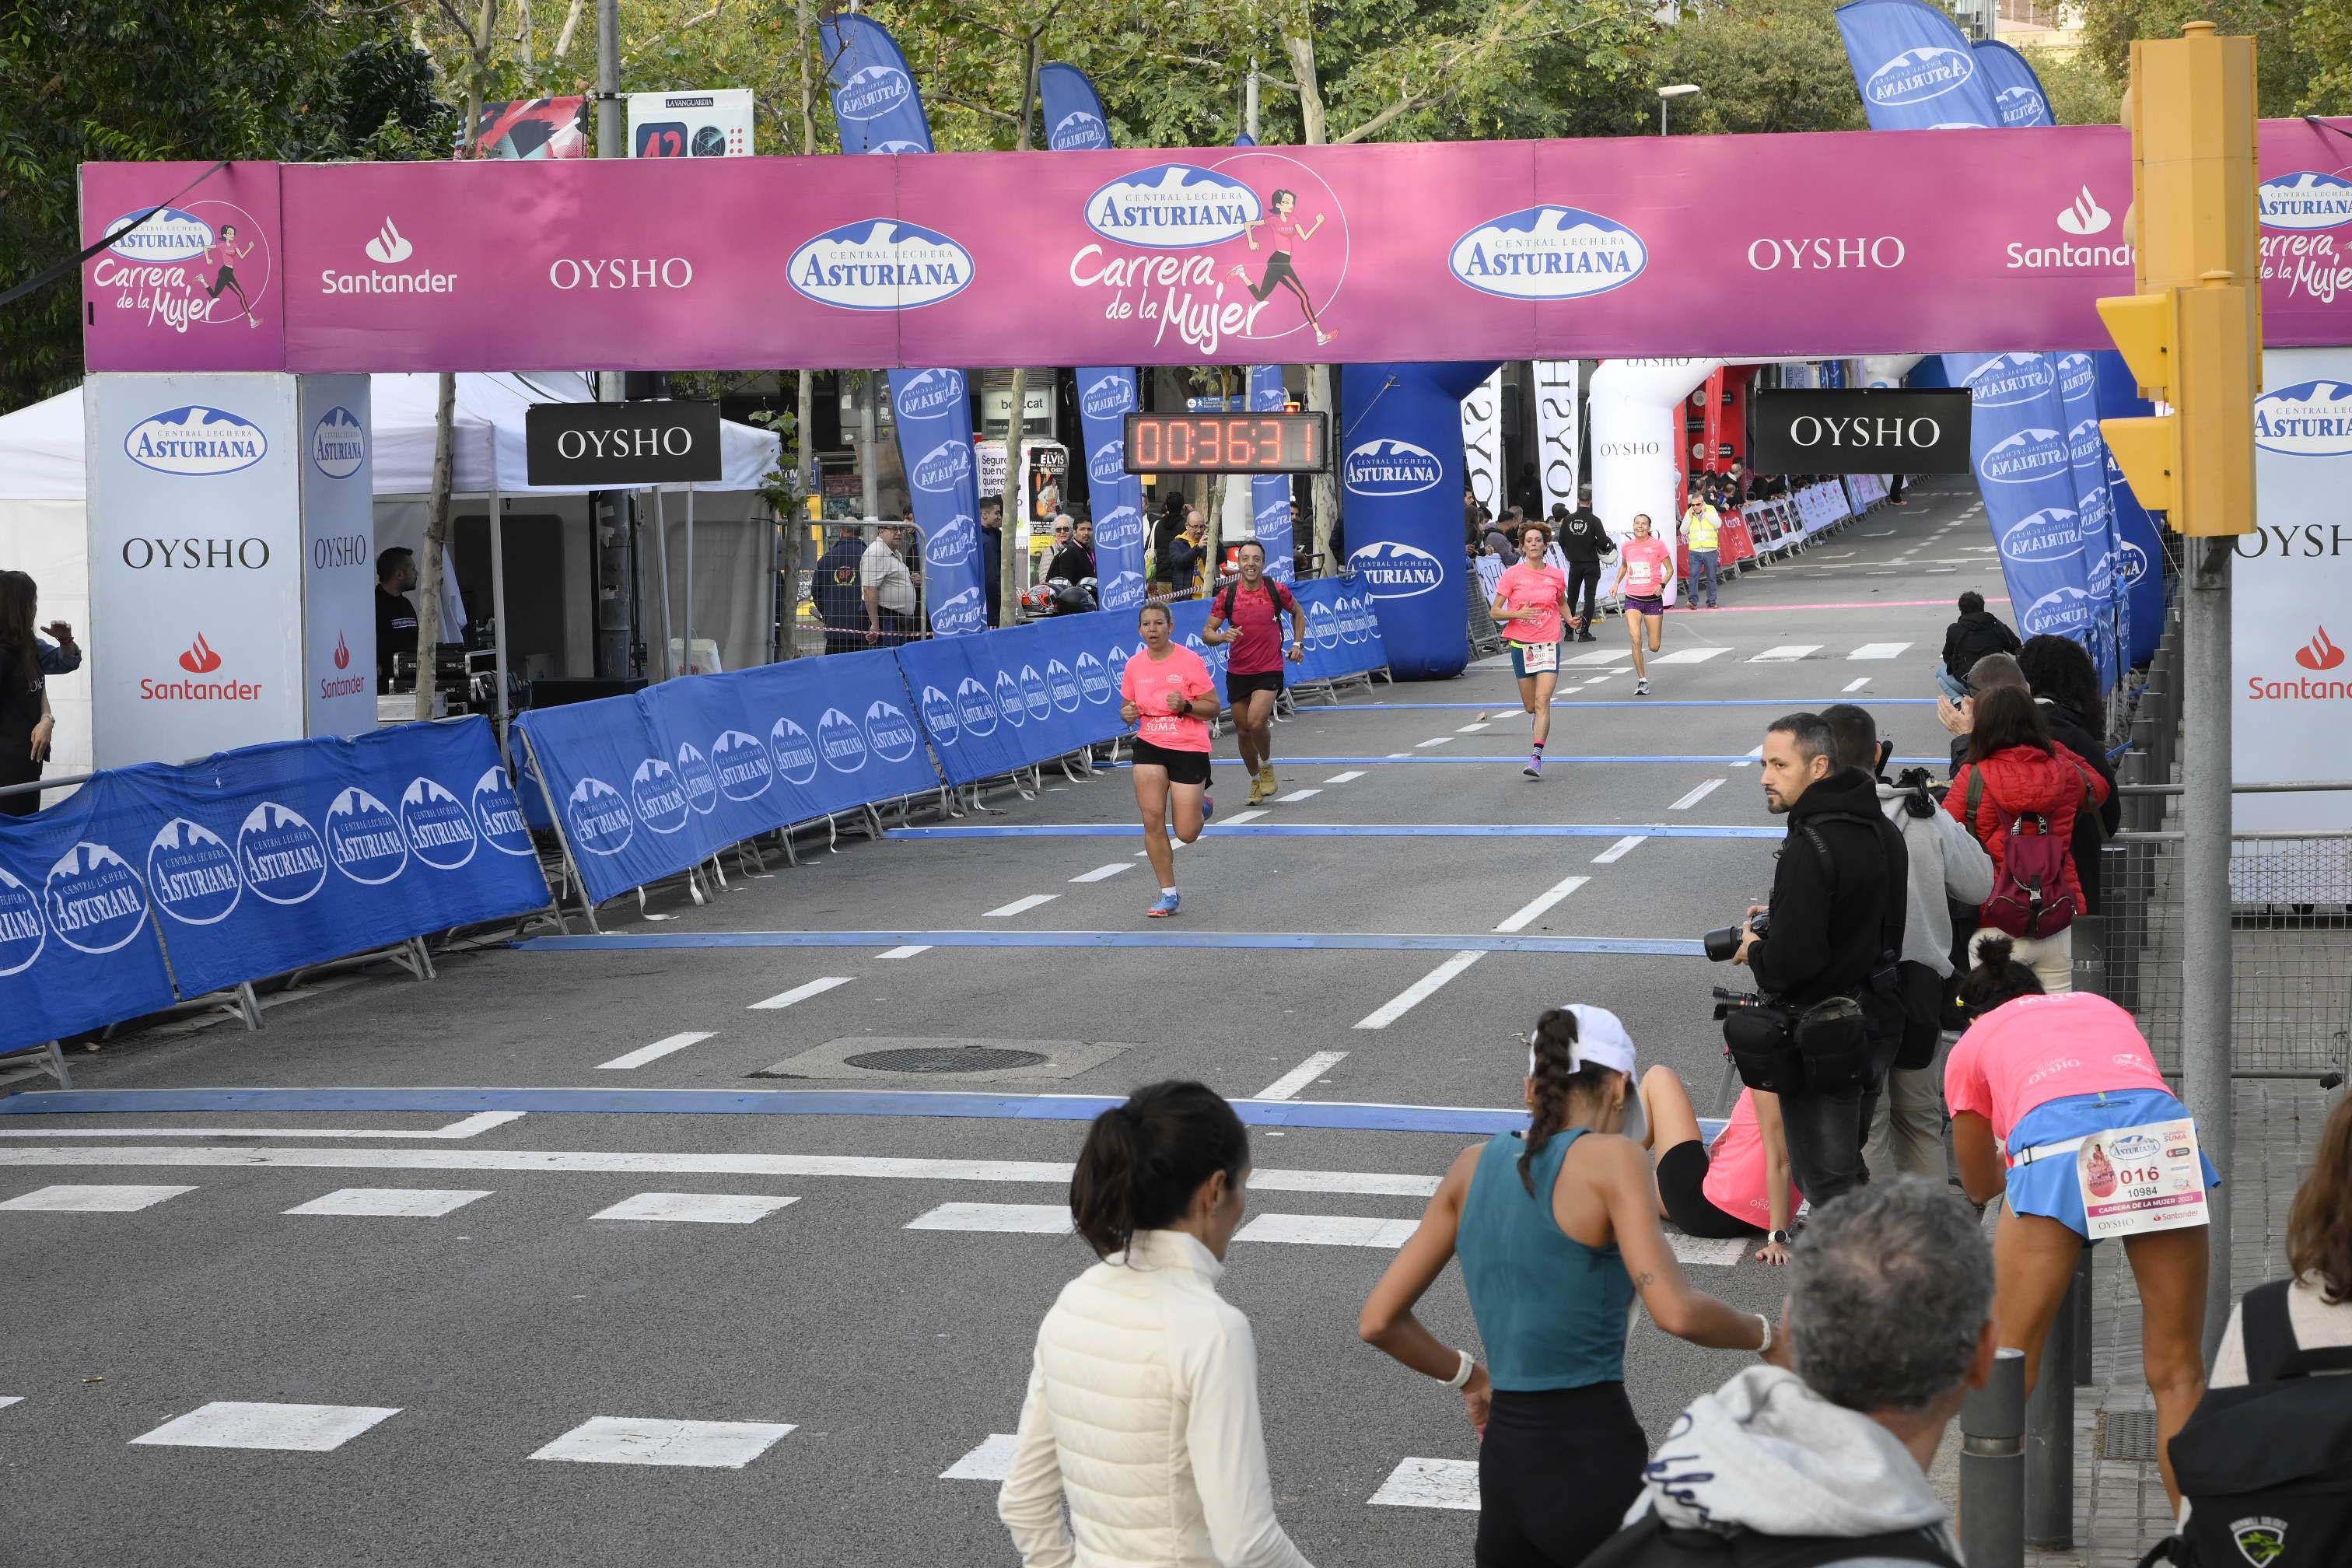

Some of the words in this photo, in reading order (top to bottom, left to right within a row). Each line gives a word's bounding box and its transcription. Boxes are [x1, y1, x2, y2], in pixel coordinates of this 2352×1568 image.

[1125, 194, 1181, 202] CENTRAL
[1187, 192, 1242, 201] LECHERA
[1098, 196, 1247, 227] ASTURIANA
[830, 250, 888, 259] CENTRAL
[894, 250, 953, 258] LECHERA
[1496, 238, 1556, 248] CENTRAL
[1563, 236, 1625, 246] LECHERA
[1747, 236, 1905, 270] OYSHO
[2259, 234, 2333, 257] arrera
[1069, 243, 1216, 287] Carrera
[1465, 241, 1632, 276] ASTURIANA
[2007, 242, 2136, 268] Santand
[93, 258, 186, 288] Carrera
[549, 257, 693, 291] OYSHO
[801, 253, 960, 286] ASTURIANA
[2278, 257, 2292, 279] la
[321, 270, 457, 294] Santander
[117, 289, 134, 309] de
[137, 289, 150, 309] la
[147, 284, 221, 333] Mujer
[1105, 289, 1132, 320] de
[1139, 289, 1158, 320] la
[1154, 282, 1269, 355] Mujer
[135, 432, 258, 457] ASTURIANA
[558, 426, 692, 460] OYSHO
[1790, 416, 1941, 448] OYSHO
[317, 434, 362, 461] ASTURIANA
[1041, 454, 1065, 464] ELVIS
[1600, 442, 1660, 457] OYSHO
[983, 468, 995, 477] que
[1347, 462, 1436, 483] ASTURIANA
[122, 537, 271, 570] OYSHO
[314, 534, 366, 570] OYSHO
[140, 677, 263, 701] Santander
[321, 674, 365, 699] Santander
[1146, 722, 1178, 731] SUMA
[775, 745, 815, 770] ASTURIANA
[822, 735, 865, 759] ASTURIANA
[716, 758, 771, 787] ASTURIANA
[341, 820, 366, 832] CENTRAL
[367, 817, 393, 828] LECHERA
[413, 810, 436, 821] CENTRAL
[436, 806, 460, 815] LECHERA
[480, 803, 527, 836] ASTUR
[254, 837, 282, 852] CENTRAL
[283, 831, 311, 844] LECHERA
[407, 814, 474, 849] ASTURIANA
[333, 827, 404, 864] ASTURIANA
[166, 855, 195, 869] CENTRAL
[196, 849, 226, 863] LECHERA
[245, 845, 324, 884] ASTURIANA
[157, 862, 238, 904] ASTURIANA
[54, 885, 142, 933] ASTURIANA
[2028, 1058, 2081, 1084] OYSHO
[2114, 1143, 2158, 1157] ASTURIANA
[2120, 1166, 2160, 1185] 016
[2127, 1186, 2158, 1198] 10984
[2098, 1203, 2131, 1214] CARRERA
[2153, 1199, 2175, 1207] MUJER
[2098, 1218, 2134, 1231] OYSHO
[2161, 1209, 2199, 1222] Santander
